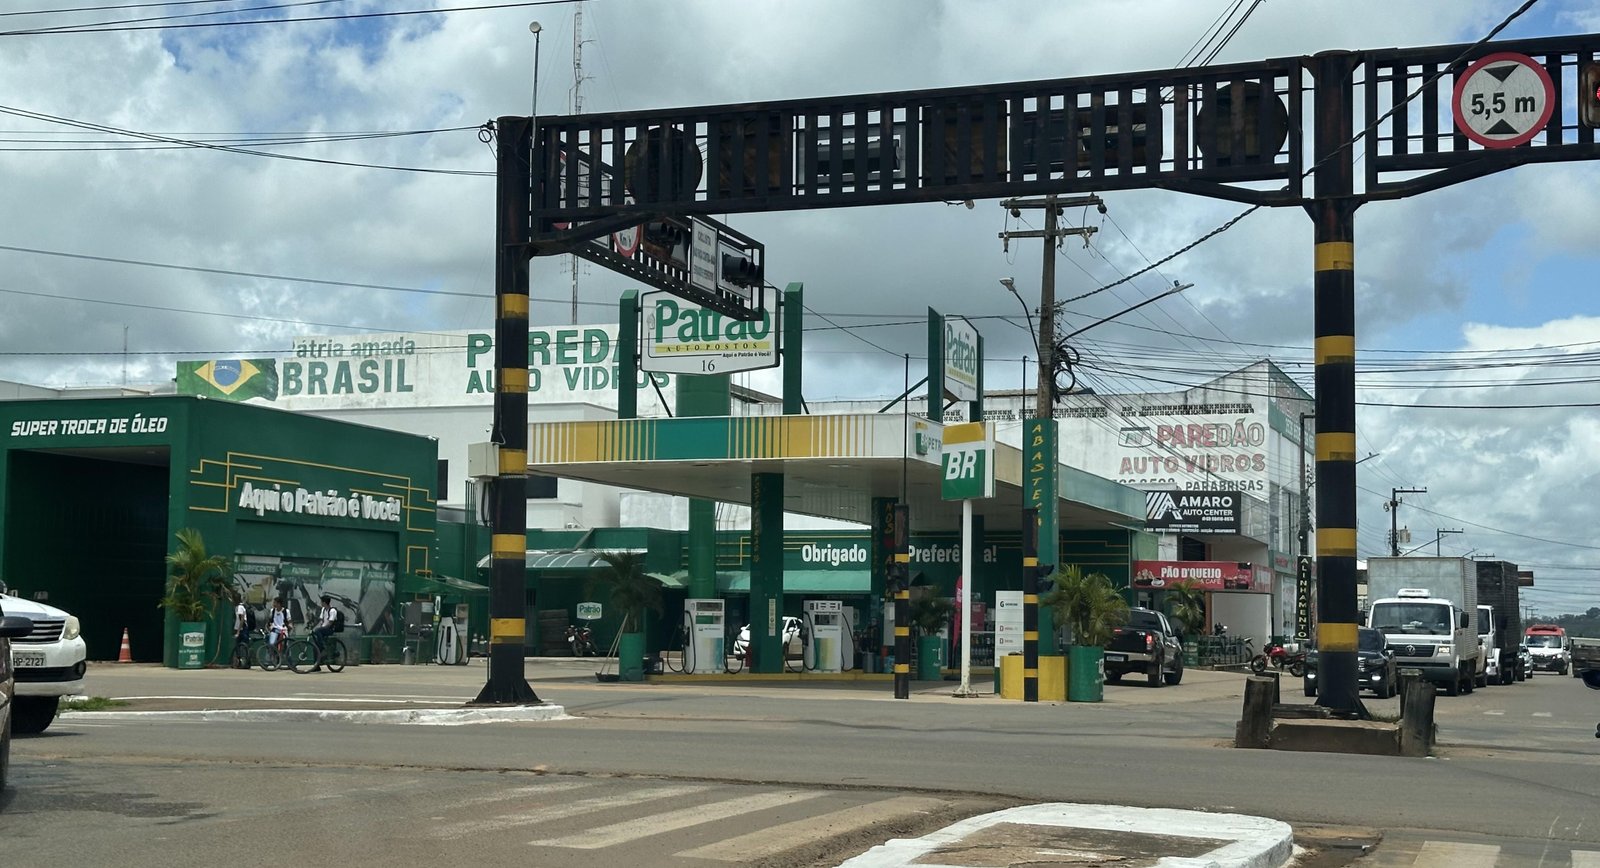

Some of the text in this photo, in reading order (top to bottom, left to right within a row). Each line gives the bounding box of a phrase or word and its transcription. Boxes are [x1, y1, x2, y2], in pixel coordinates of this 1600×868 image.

[1471, 92, 1536, 120] 5,5 m
[293, 336, 416, 359] átria amada
[466, 328, 620, 368] PRED
[946, 323, 976, 376] Patrão
[282, 358, 414, 397] BRASIL
[702, 359, 716, 372] 16
[466, 367, 542, 394] AUO
[11, 413, 168, 436] SUPER TROCA DE ÓLEO
[1156, 417, 1266, 449] PAREDÃO
[945, 449, 977, 480] BR
[1119, 453, 1266, 475] AUTO VIDROS
[1186, 479, 1264, 491] PARABRISAS
[238, 482, 401, 523] Aqui o Patrão é Você!
[1180, 496, 1233, 507] AMARO
[801, 544, 867, 566] Obrigado
[1161, 565, 1222, 580] PÃO D'QUEIJO
[580, 604, 600, 614] Patrão
[1298, 557, 1309, 637] ALINHAMENTO
